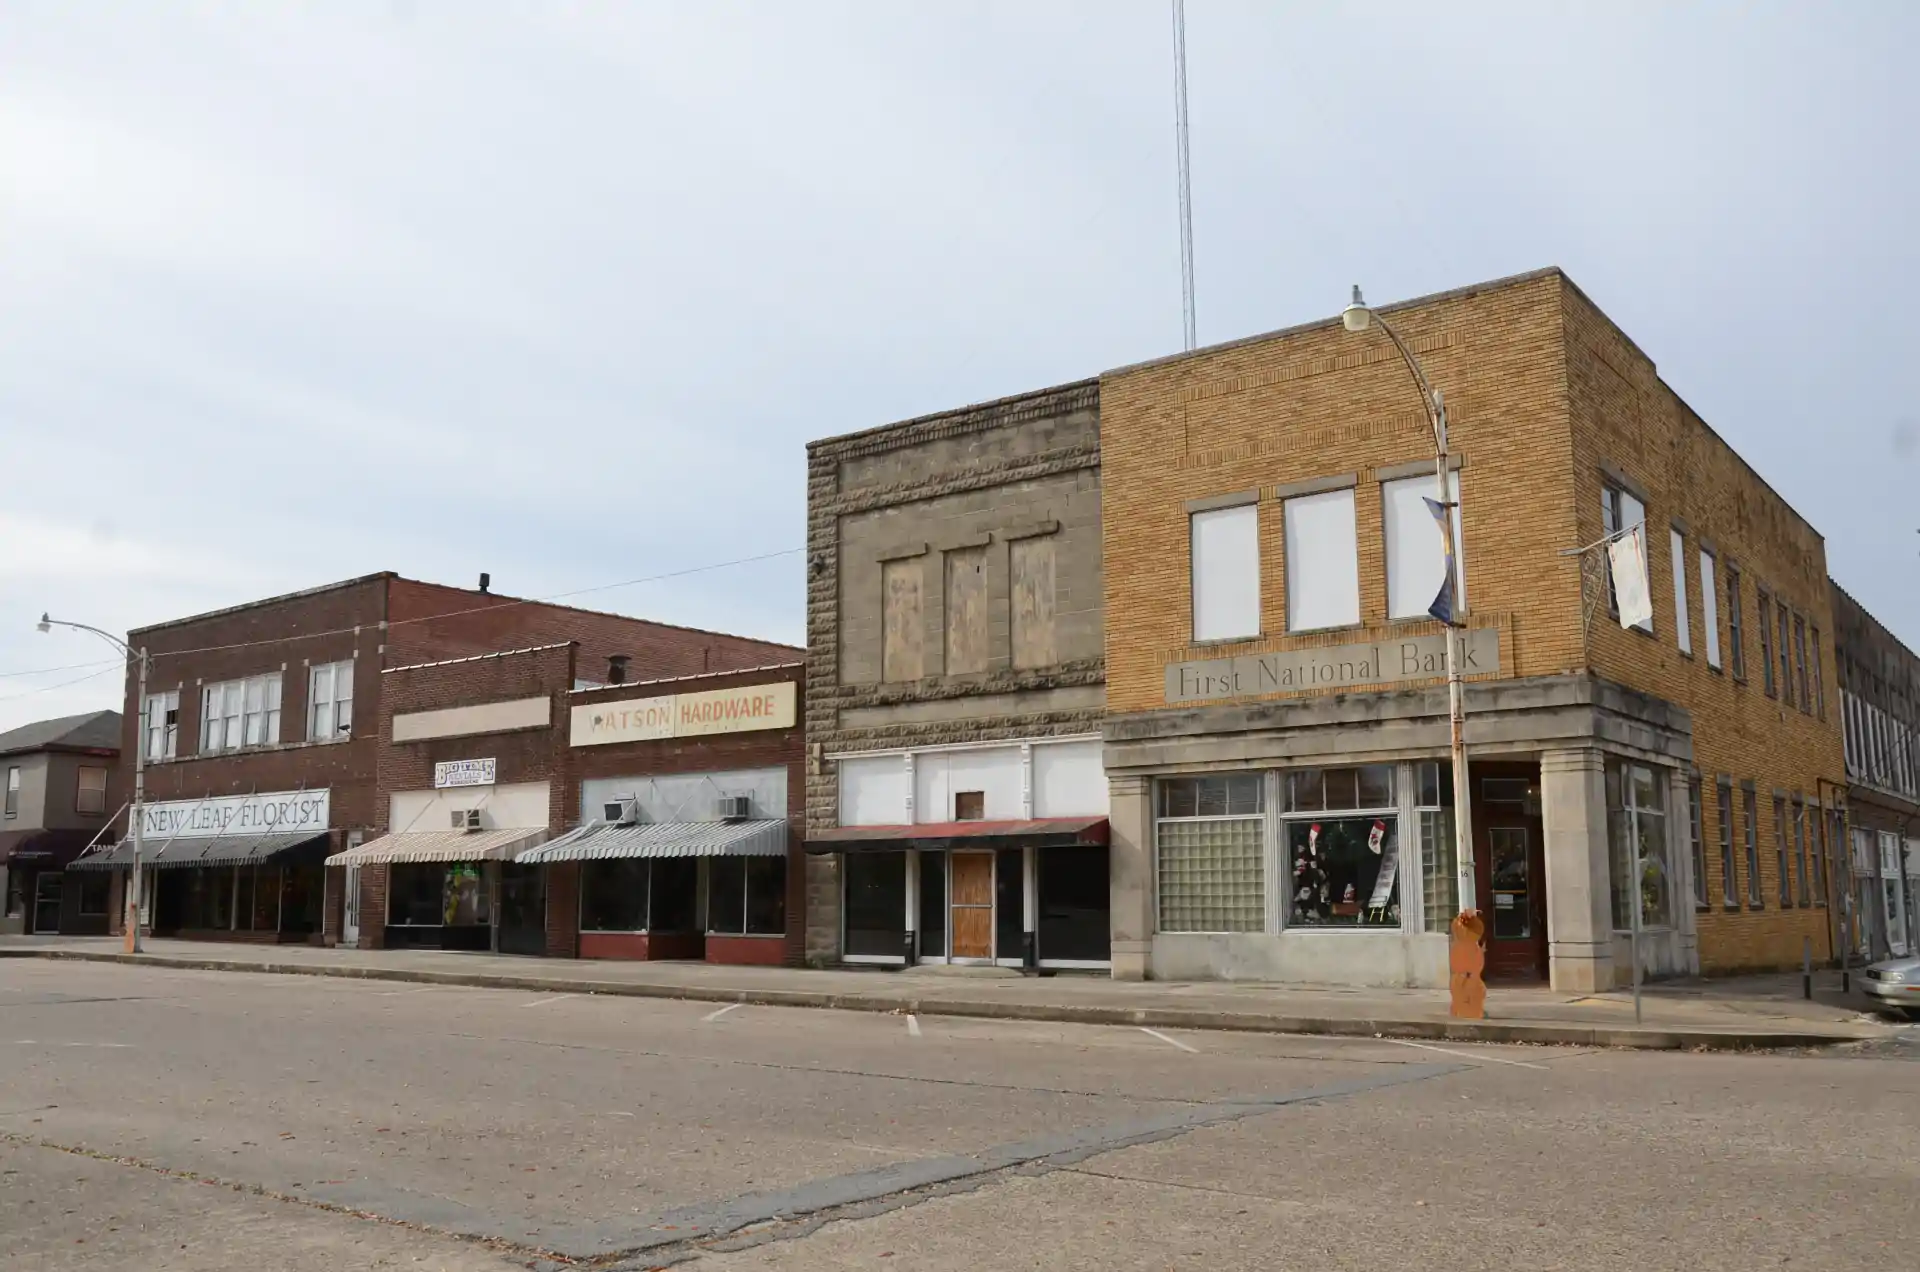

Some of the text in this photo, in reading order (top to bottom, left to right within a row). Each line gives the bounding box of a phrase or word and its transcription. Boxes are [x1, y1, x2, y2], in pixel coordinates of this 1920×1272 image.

[1180, 667, 1243, 696] First
[1258, 647, 1381, 690] National
[681, 694, 776, 725] HARDWARE
[147, 809, 185, 832] NEW
[190, 805, 233, 830] LEAF
[240, 800, 324, 827] FLORIST
